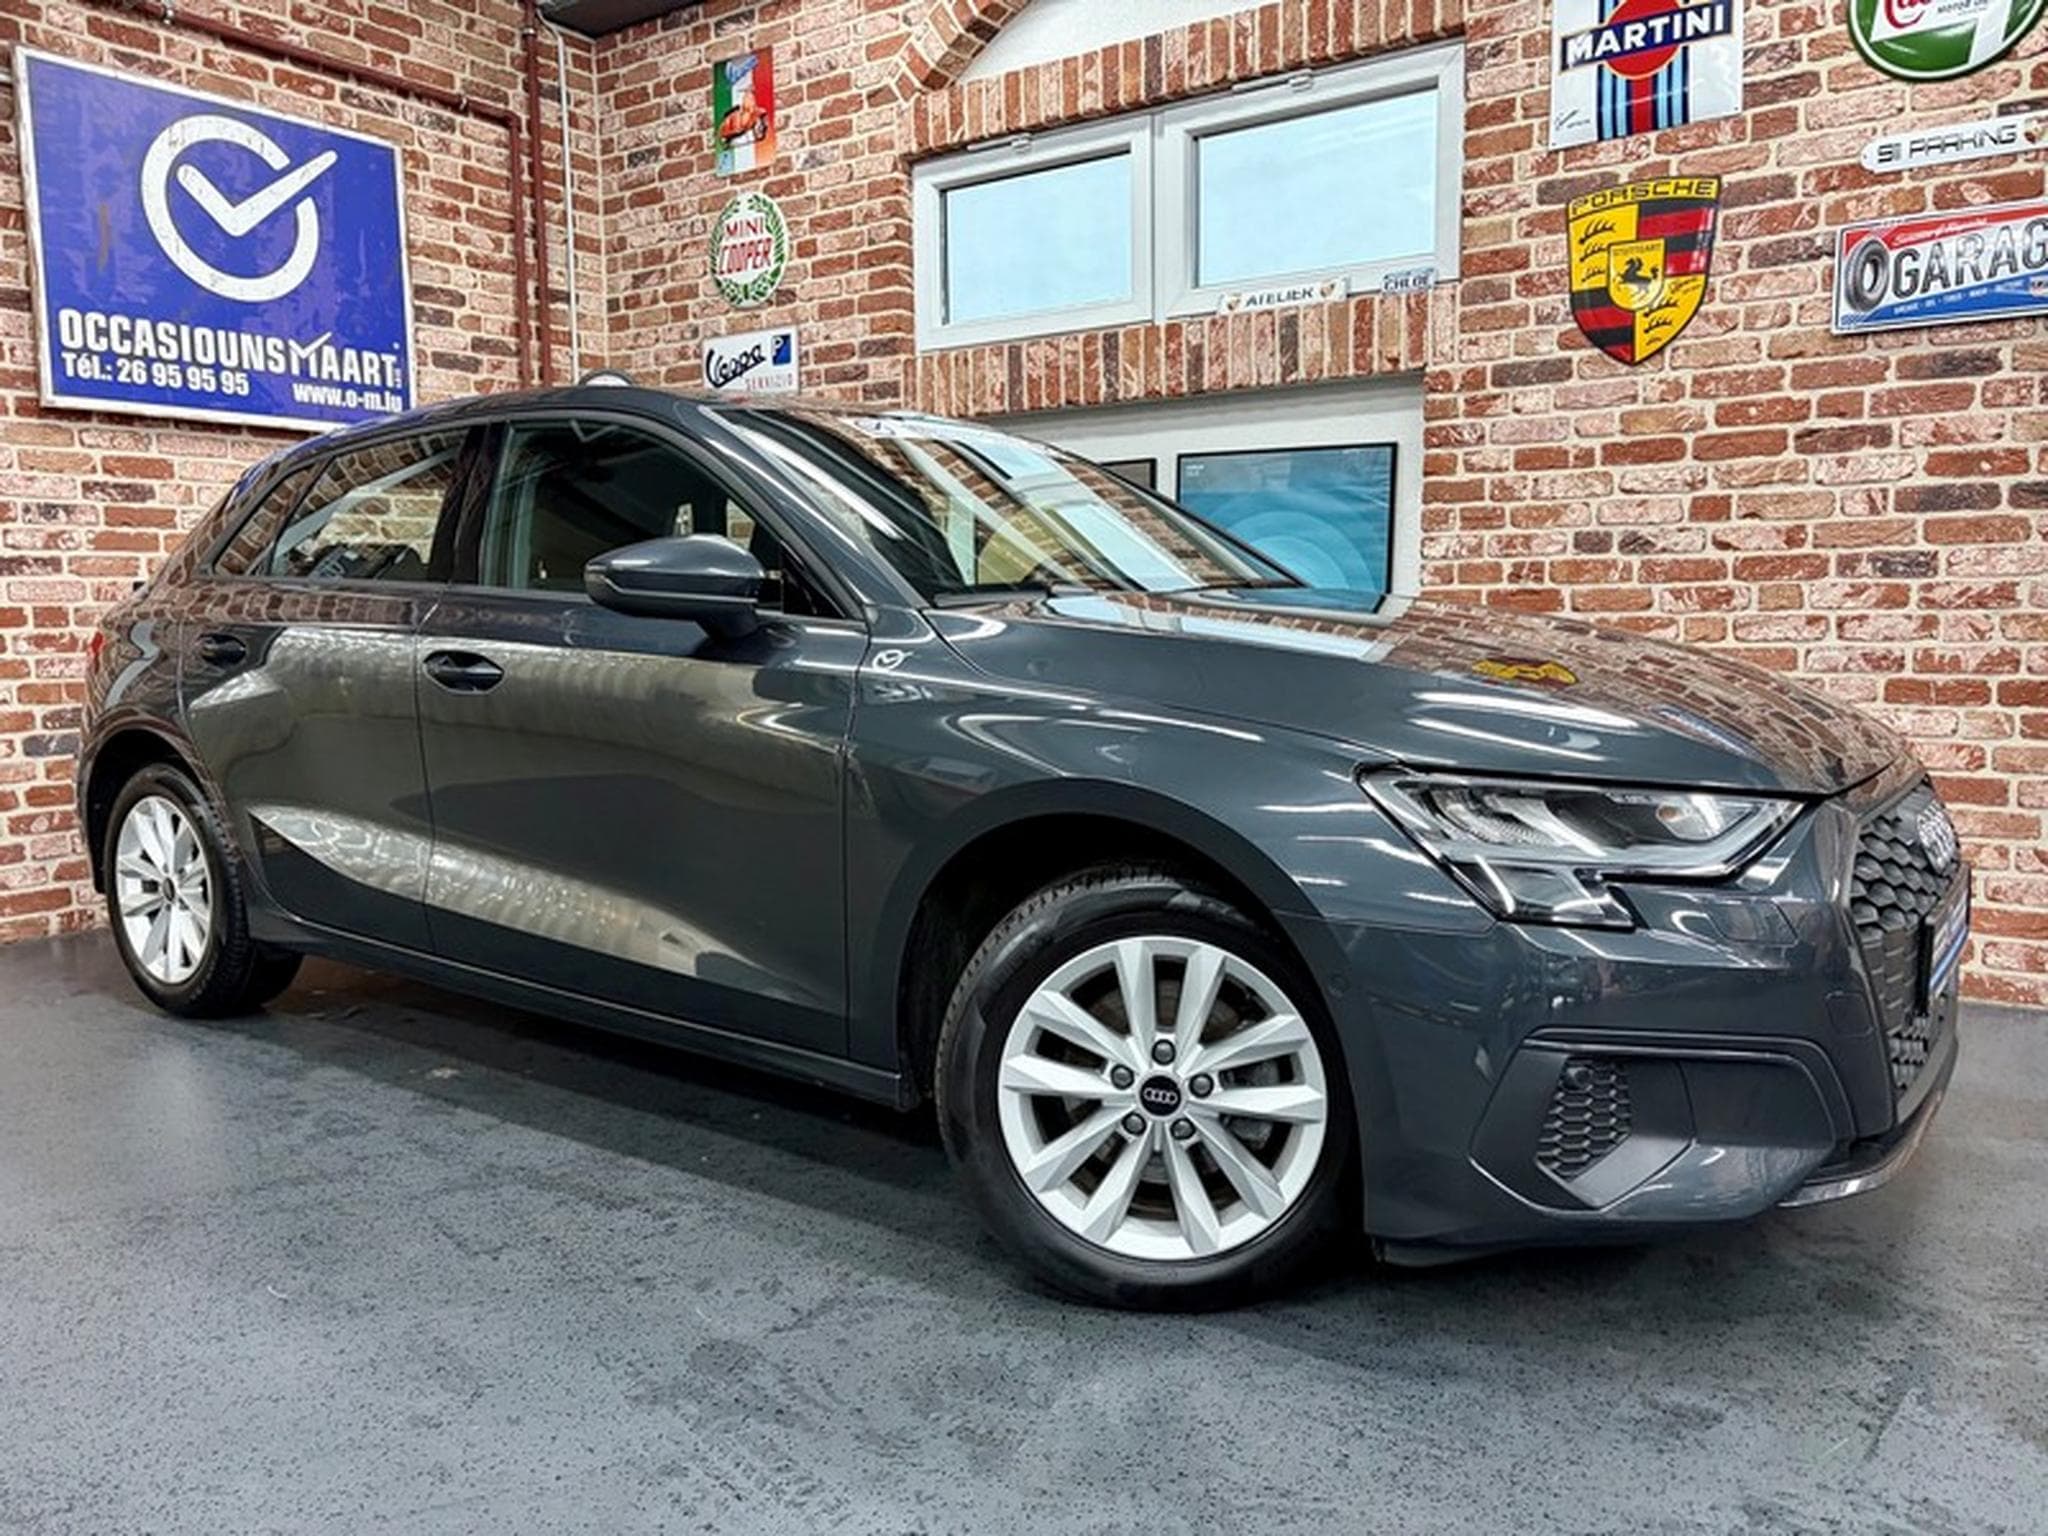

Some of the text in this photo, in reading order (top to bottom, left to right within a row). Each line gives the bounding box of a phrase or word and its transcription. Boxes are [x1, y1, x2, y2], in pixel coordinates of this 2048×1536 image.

[1566, 4, 1725, 67] MARTINI
[1908, 123, 2018, 159] PARKING
[1571, 180, 1715, 216] PORSCHE
[725, 216, 764, 238] MINI
[718, 237, 773, 277] COOPER
[1245, 287, 1314, 307] ATELIER
[62, 351, 250, 397] Tél.: 26 95 95 95
[292, 382, 403, 413] www.o-m.lu
